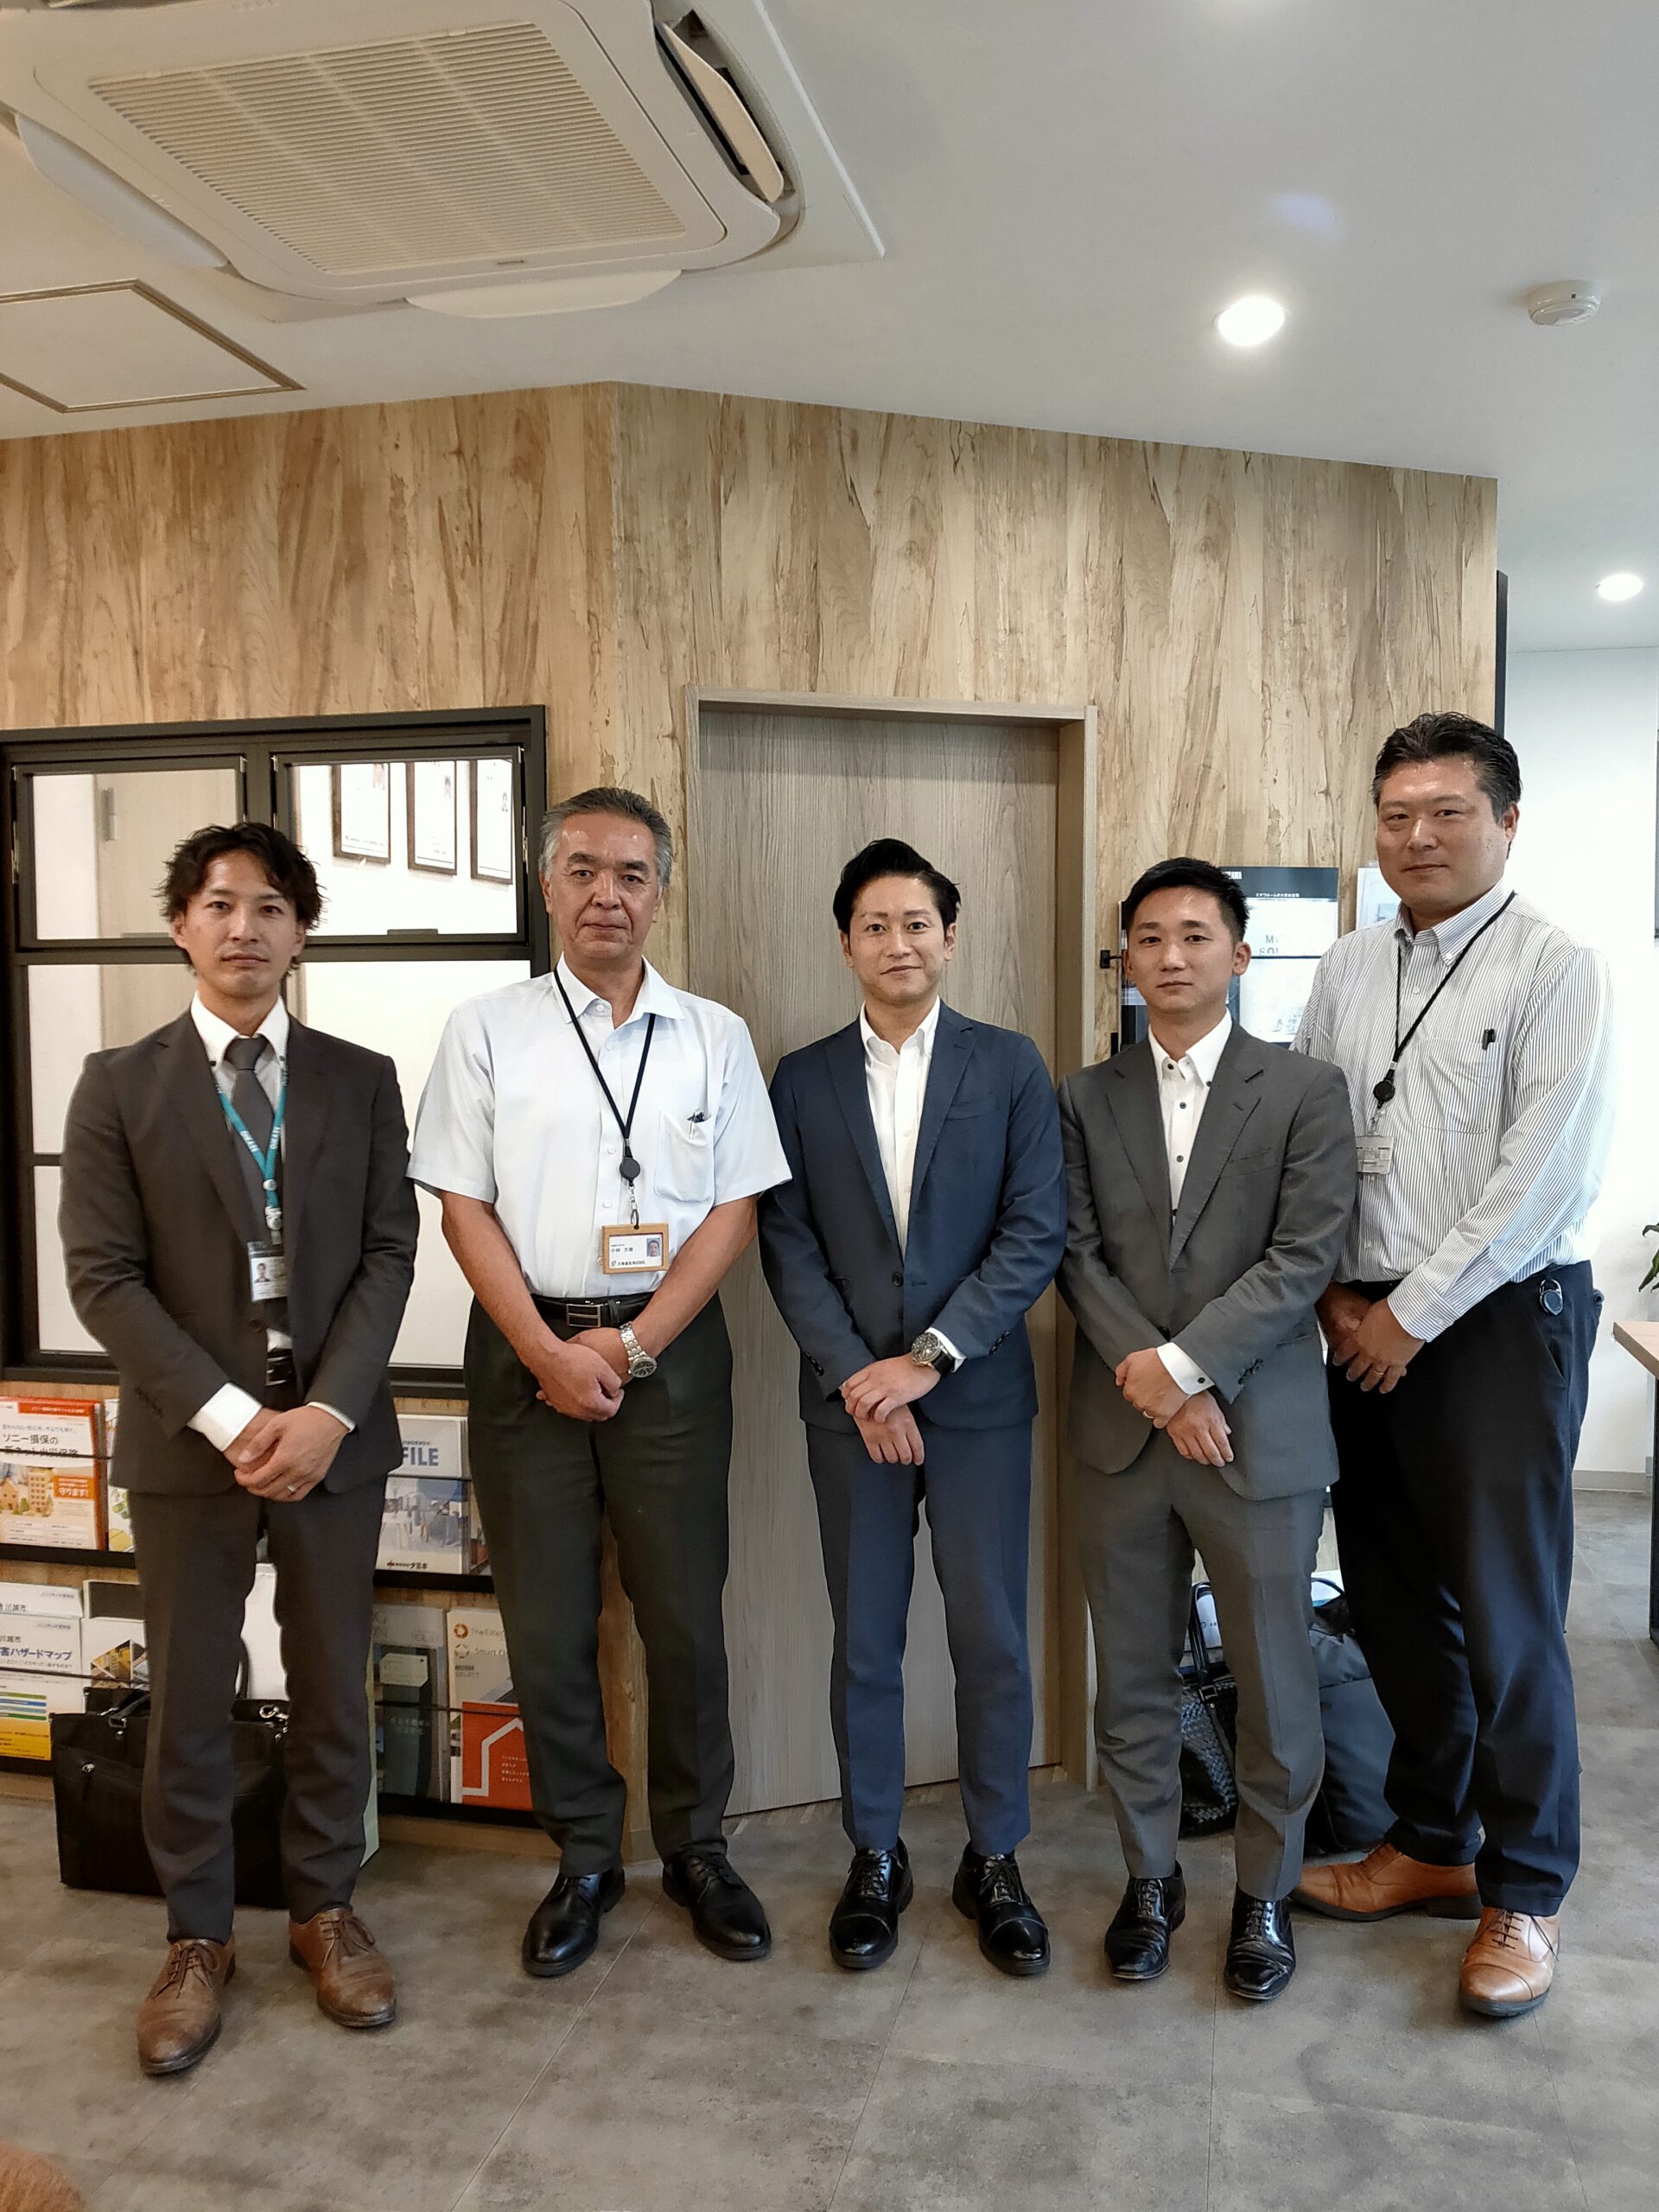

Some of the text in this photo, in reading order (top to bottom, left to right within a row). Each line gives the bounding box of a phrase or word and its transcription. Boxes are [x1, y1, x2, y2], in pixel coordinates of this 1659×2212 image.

[3, 1433, 59, 1445] ソニー損保の
